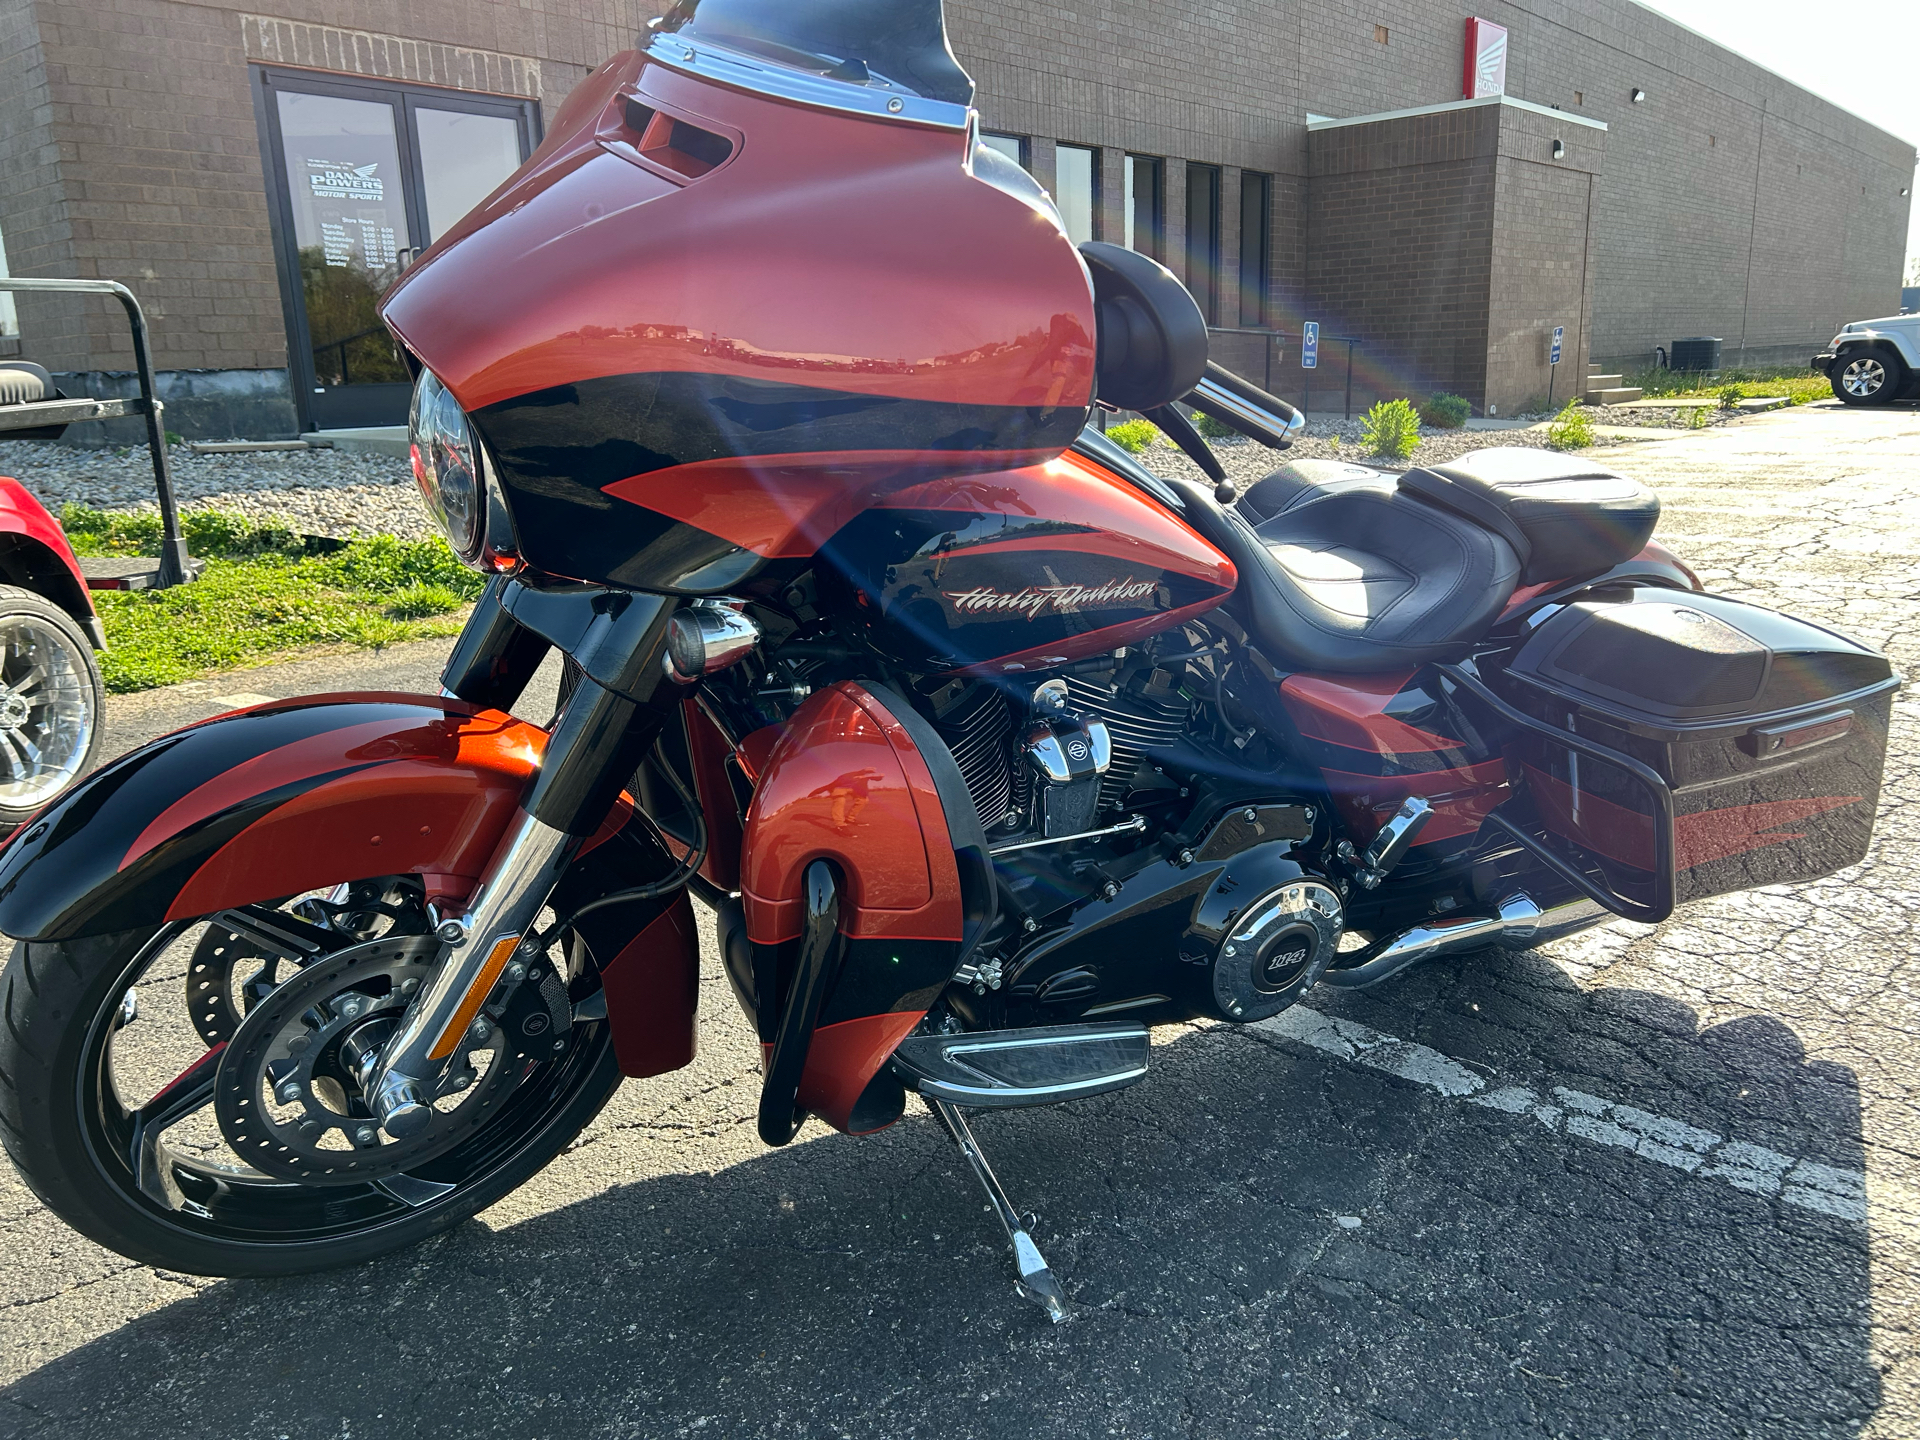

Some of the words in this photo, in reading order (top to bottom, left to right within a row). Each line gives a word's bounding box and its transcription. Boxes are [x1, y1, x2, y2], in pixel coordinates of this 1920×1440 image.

[325, 171, 354, 180] DAN
[310, 175, 383, 189] POWERS
[314, 190, 346, 198] MOTOR
[349, 193, 383, 201] SPORTS
[323, 235, 354, 243] Wednesday
[324, 241, 349, 249] Thursday
[325, 253, 350, 261] Saturday
[942, 575, 1157, 622] Harley-Davidson
[1268, 948, 1306, 970] 114
